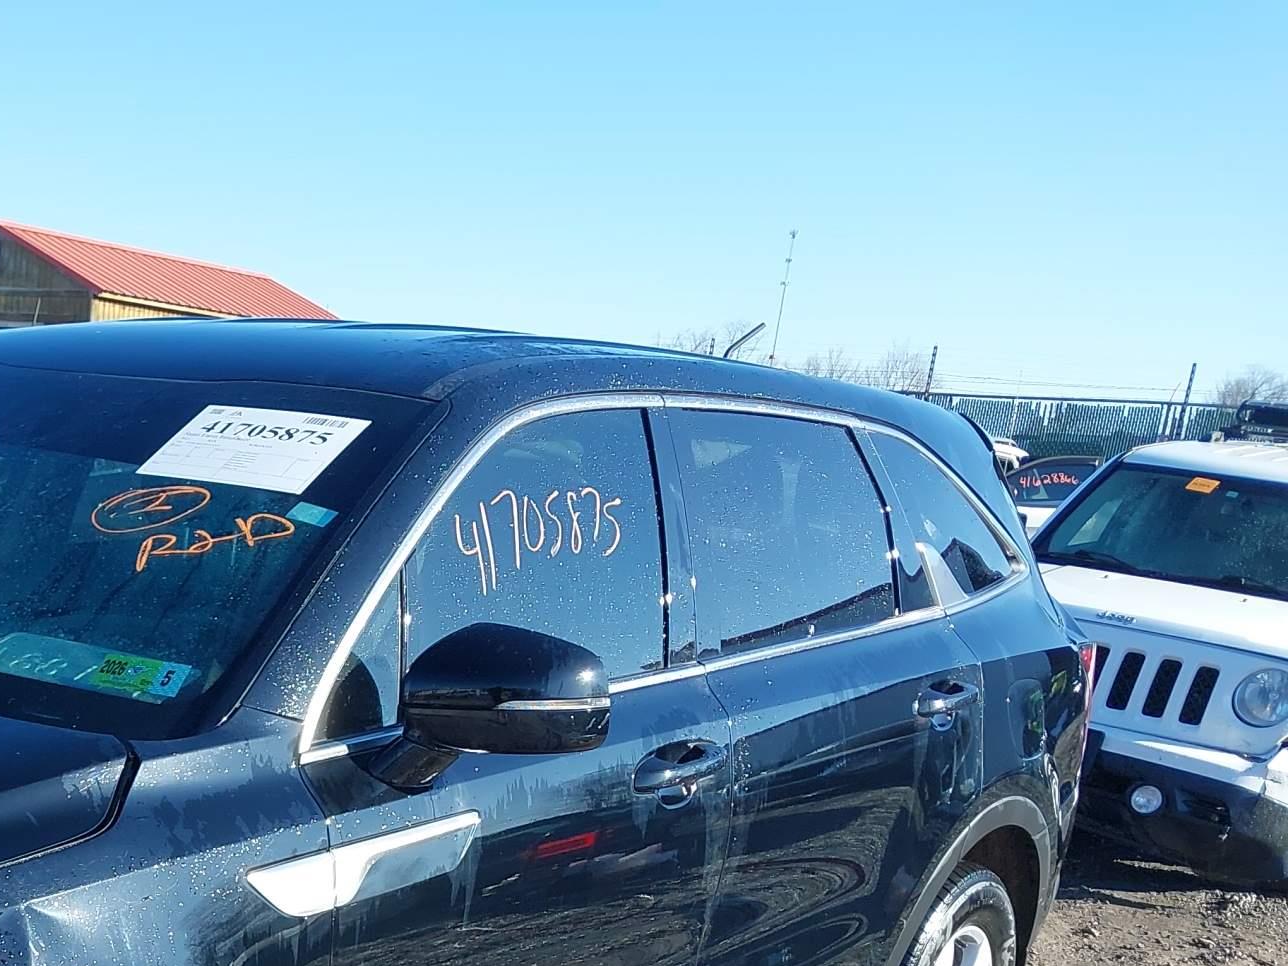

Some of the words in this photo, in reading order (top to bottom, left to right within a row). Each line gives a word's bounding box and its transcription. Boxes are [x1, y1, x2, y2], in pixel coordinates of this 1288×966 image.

[200, 420, 335, 446] 41705875
[453, 487, 623, 597] 41705875
[99, 659, 129, 676] 2026
[159, 669, 177, 687] 5
